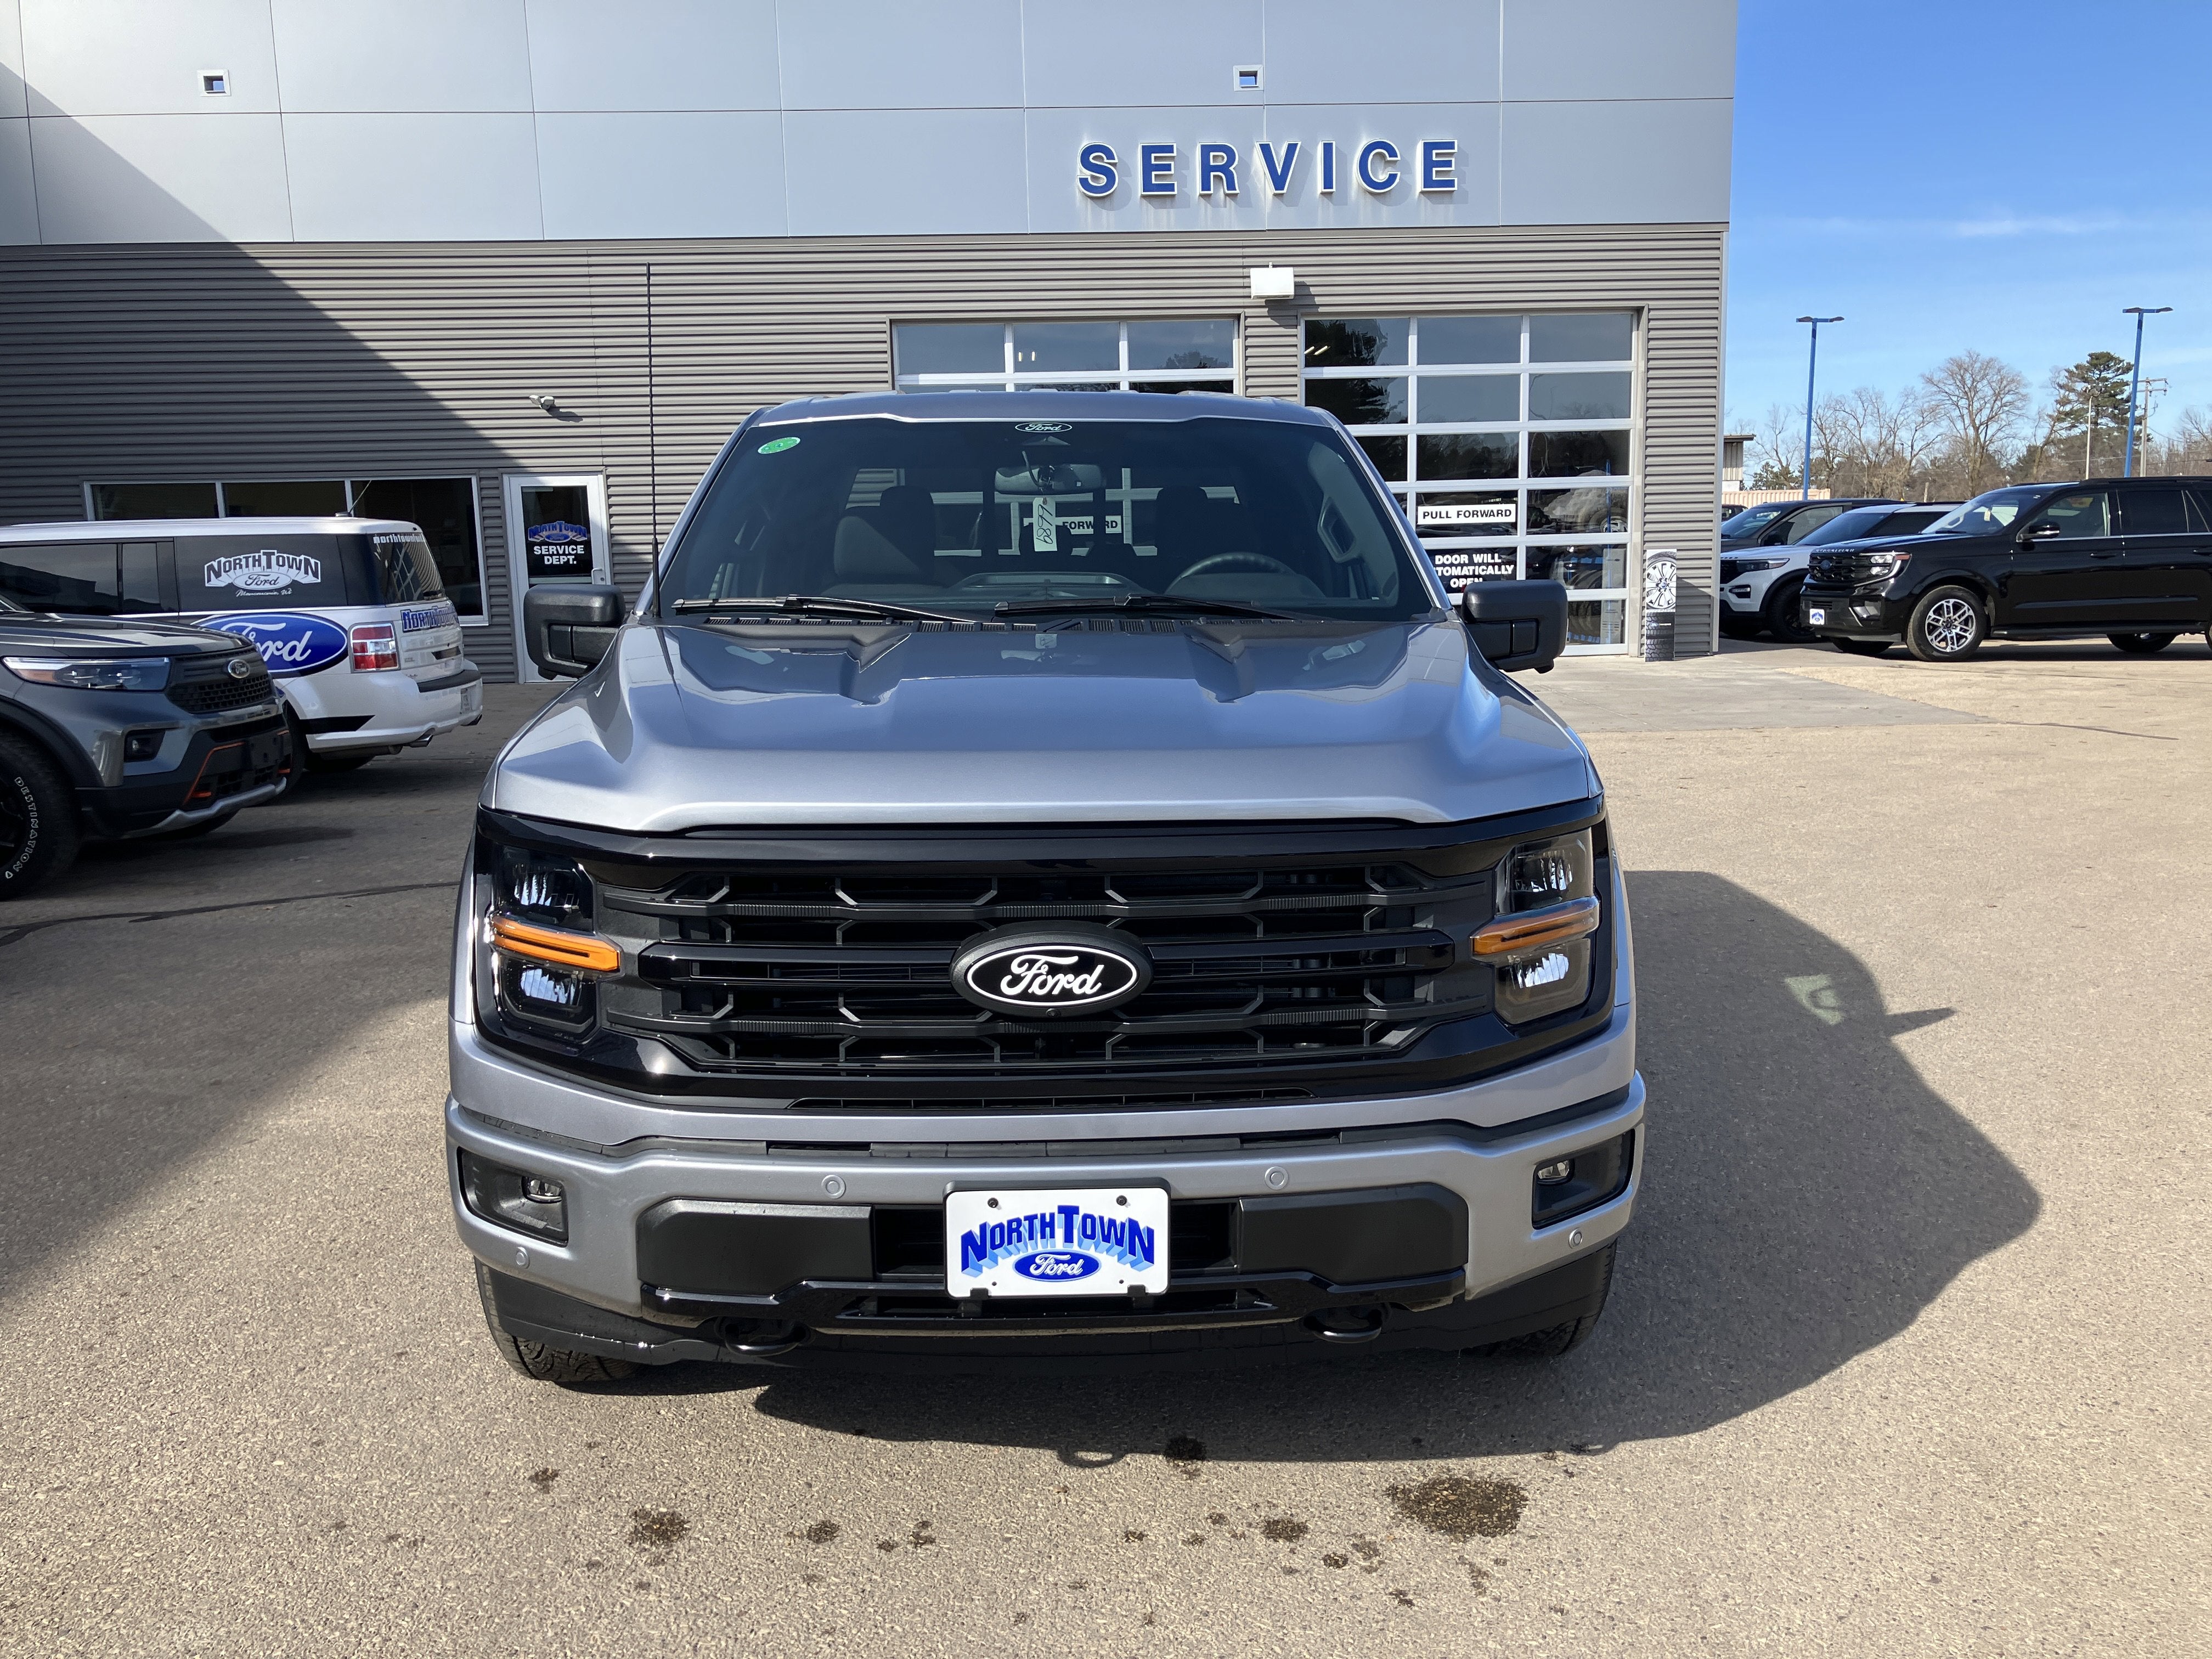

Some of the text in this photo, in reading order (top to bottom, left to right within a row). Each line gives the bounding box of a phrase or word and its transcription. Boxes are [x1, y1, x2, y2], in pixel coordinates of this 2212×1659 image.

[1077, 139, 1458, 198] SERVICE
[1423, 509, 1512, 519] PULL FORWARD
[1063, 520, 1118, 530] FORWRD
[533, 545, 585, 555] SERVICE
[544, 555, 577, 565] DEPT.
[1435, 553, 1502, 565] DOOR WILL
[1434, 565, 1515, 576] TOMATICALLY
[245, 574, 280, 586] Ford
[221, 622, 313, 662] Frd
[13, 777, 39, 872] DESTINATION
[1000, 954, 1104, 996] Ford
[1030, 1253, 1085, 1276] Ford
